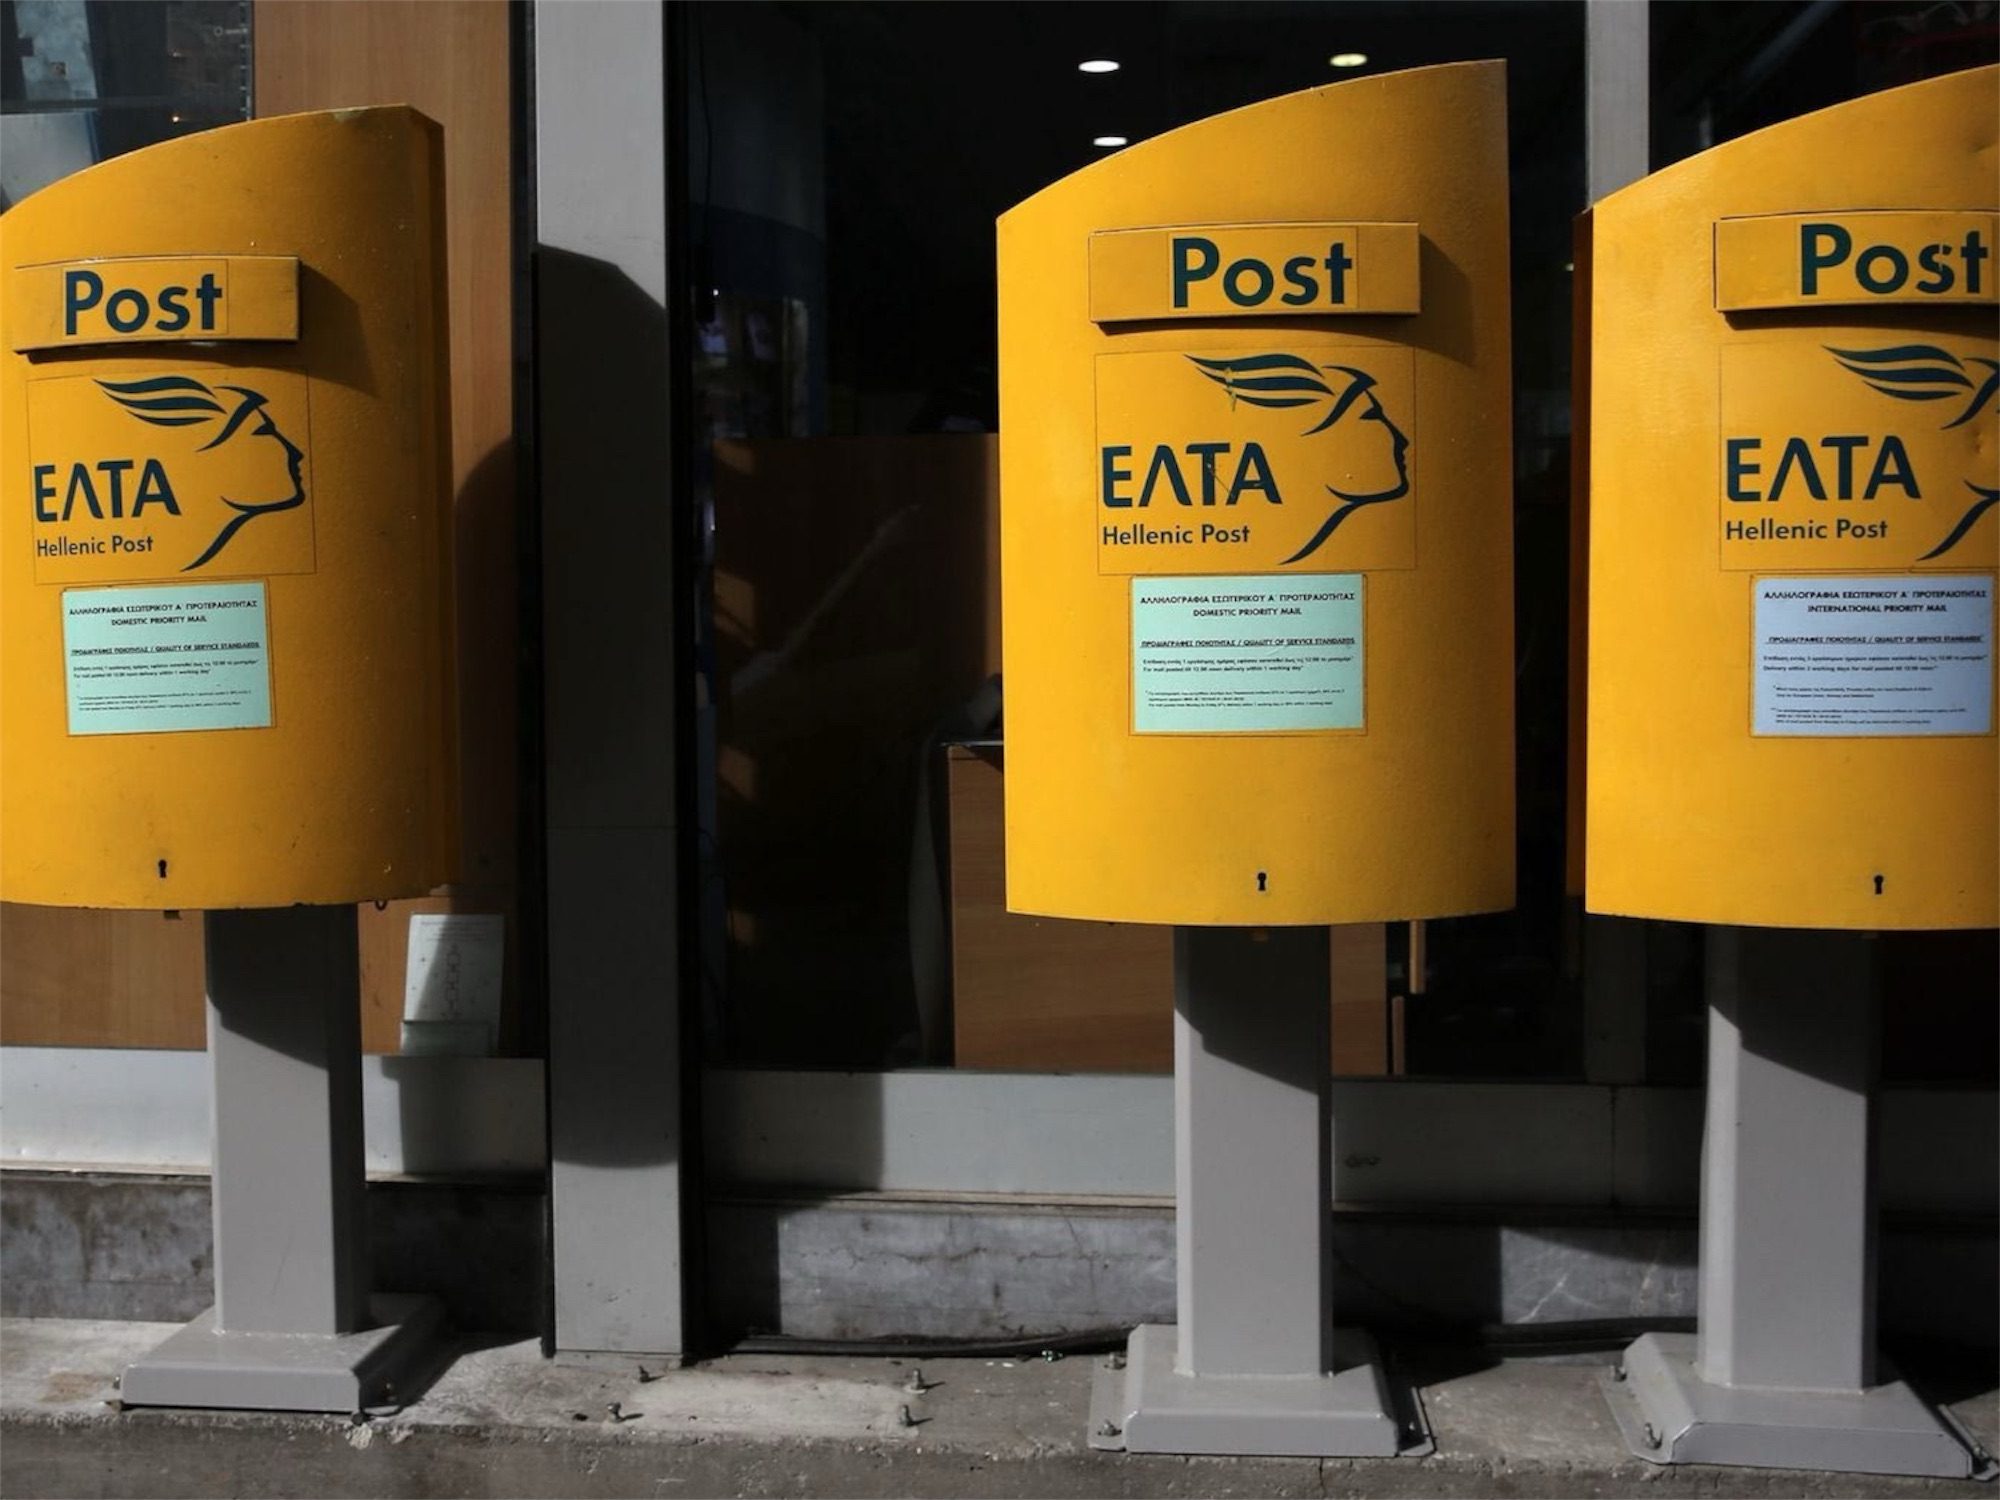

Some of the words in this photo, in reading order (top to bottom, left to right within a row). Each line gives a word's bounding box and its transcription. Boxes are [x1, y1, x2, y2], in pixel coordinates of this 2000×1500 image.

[1172, 237, 1352, 308] Post
[1801, 224, 1988, 295] Post
[65, 270, 222, 335] Post
[34, 458, 181, 522] ΕΛΤΑ
[1102, 442, 1282, 508] ΕΛΤΑ
[1727, 436, 1921, 502] ΕΛΤΑ
[37, 537, 106, 557] Hellenic
[112, 535, 154, 553] Post
[1103, 525, 1193, 545] Hellenic
[1202, 524, 1250, 542] Post
[1726, 519, 1828, 540] Hellenic
[1837, 519, 1888, 538] Post
[111, 617, 148, 626] DOMESTIC
[150, 615, 185, 625] PRIORITY
[187, 615, 207, 623] MAIL
[1193, 609, 1237, 617] DOMESTIC
[1239, 608, 1278, 616] PRIORITY
[1280, 607, 1302, 615] MAIL
[1807, 604, 1881, 612] INTERNATIONAL
[1884, 604, 1923, 612] PRIORITY
[1926, 604, 1947, 612] MAIL
